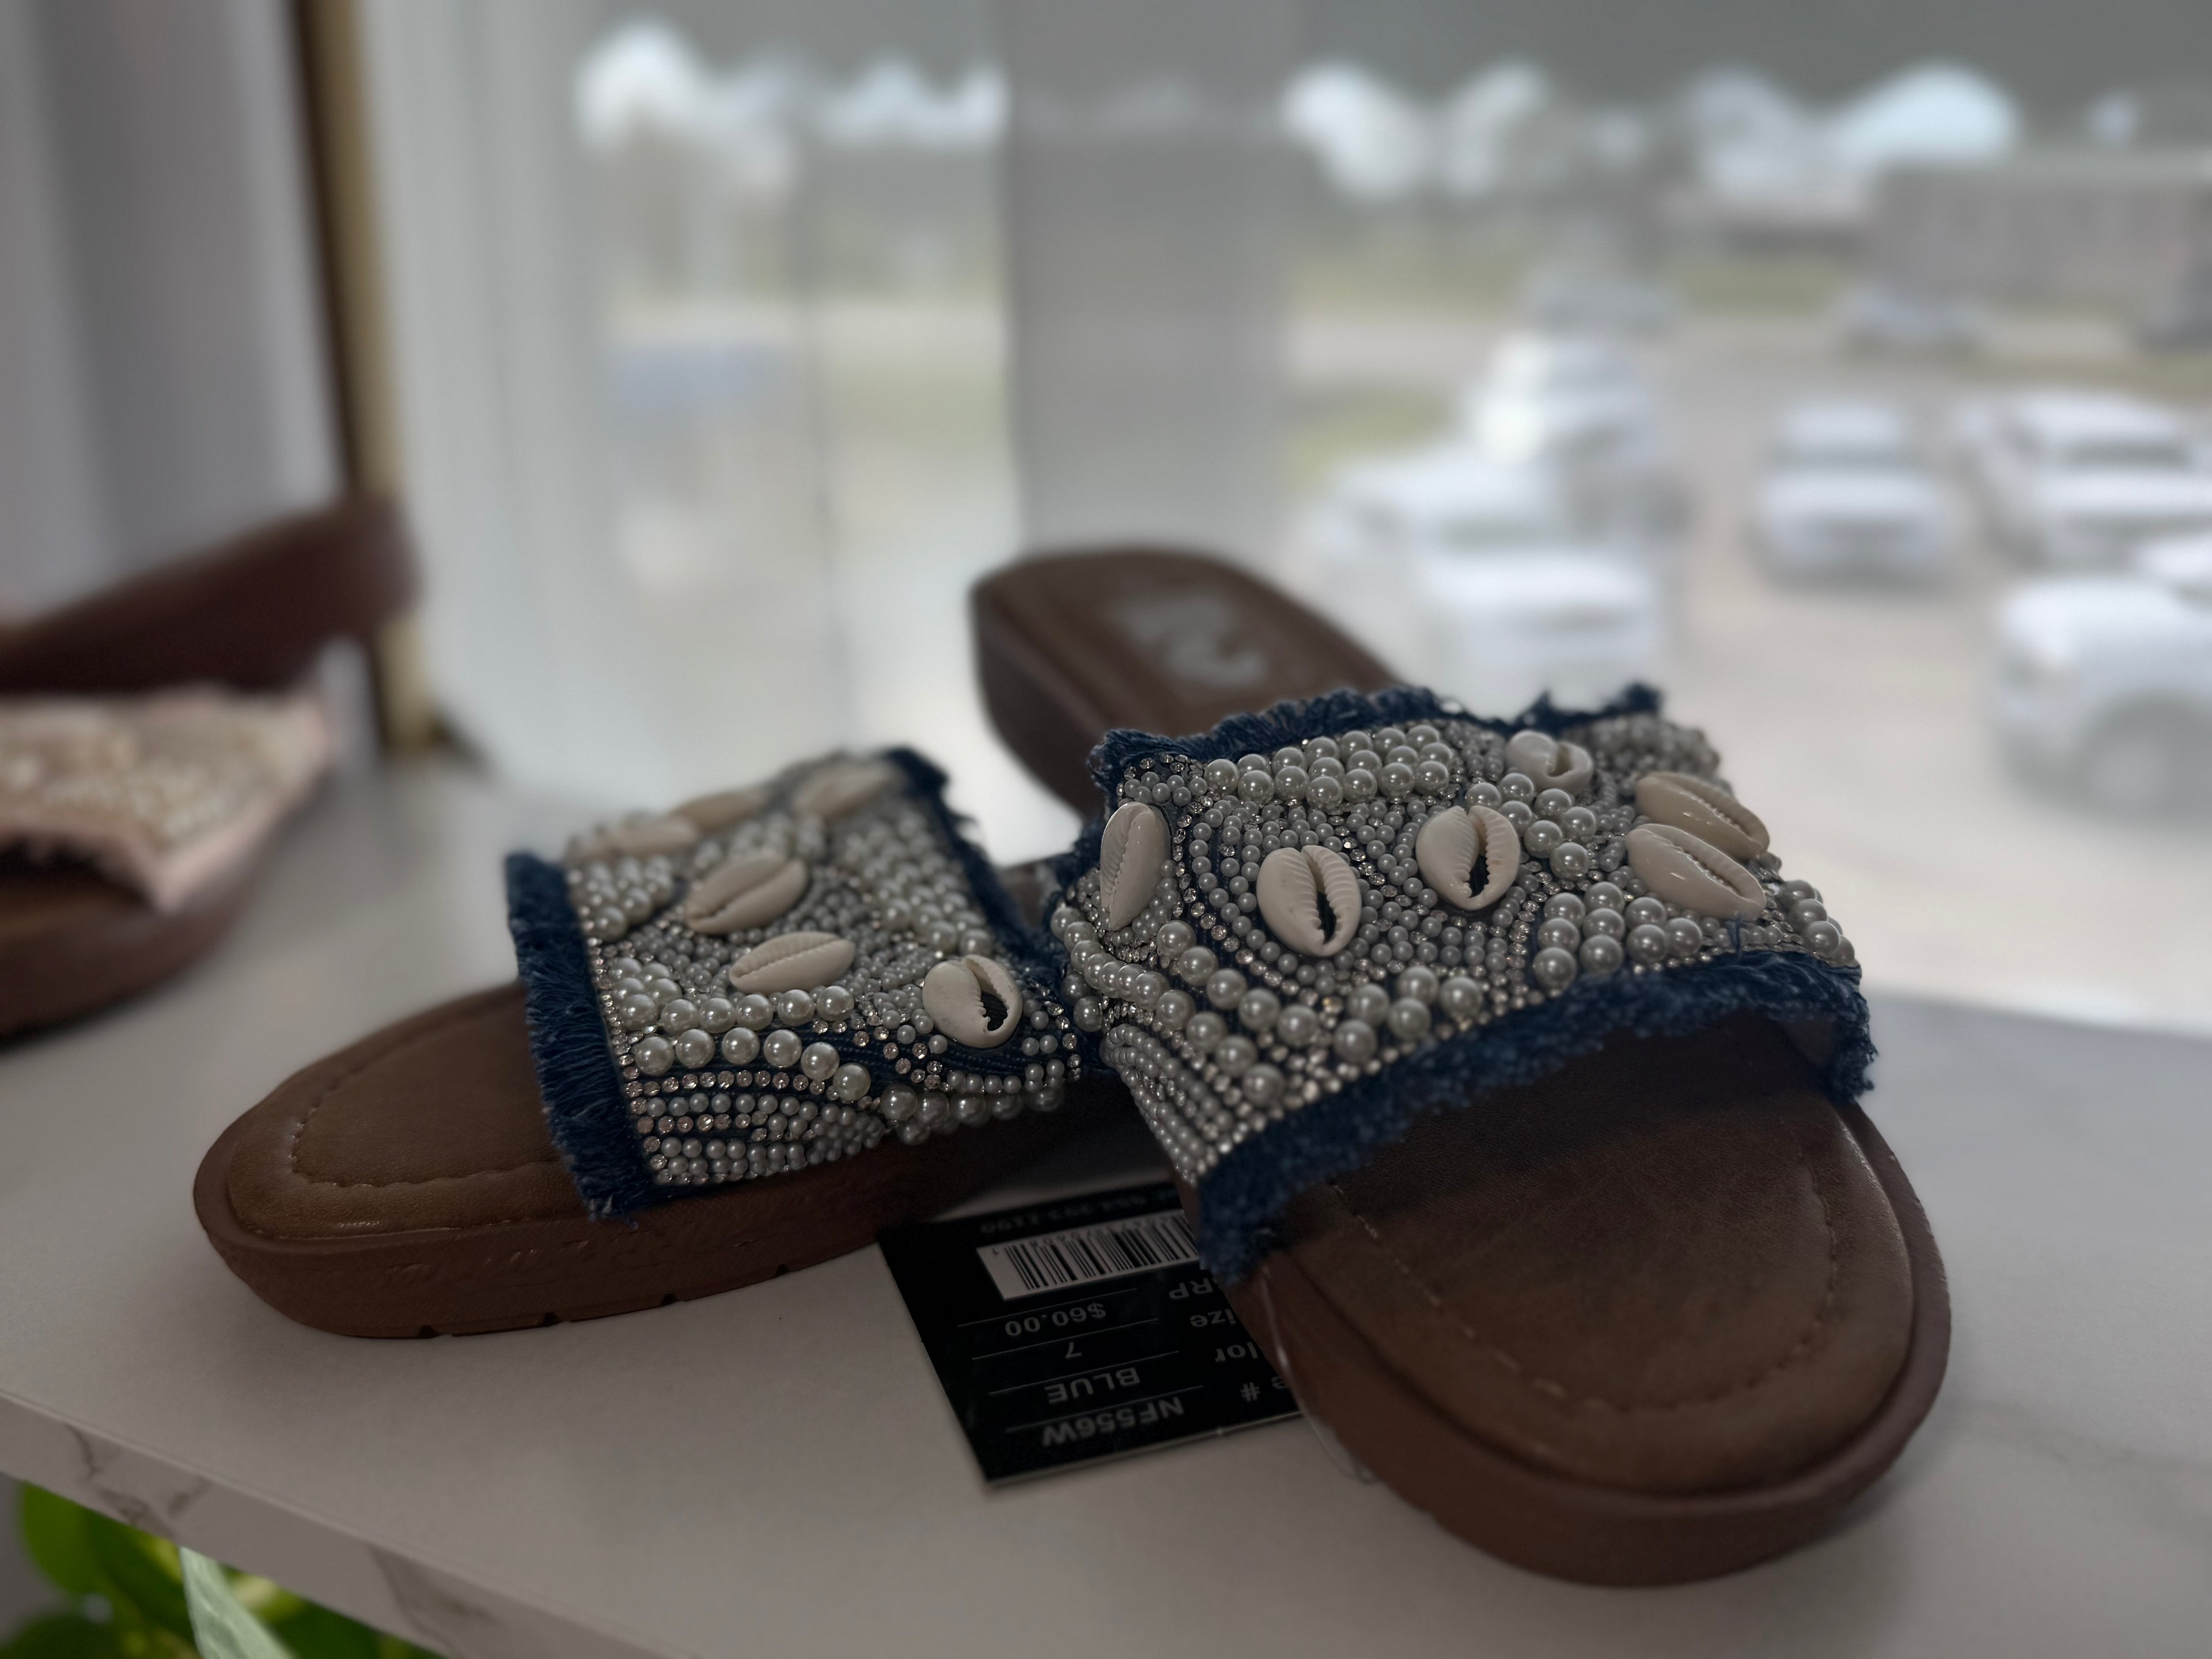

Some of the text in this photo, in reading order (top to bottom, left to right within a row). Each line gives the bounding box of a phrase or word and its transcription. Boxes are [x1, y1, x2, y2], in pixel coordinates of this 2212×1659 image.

[1005, 1277, 1215, 1337] RP $60.00
[1065, 1308, 1236, 1359] ize 7
[1043, 1341, 1258, 1406] lor BLUE
[1041, 1381, 1261, 1447] # NF556W
